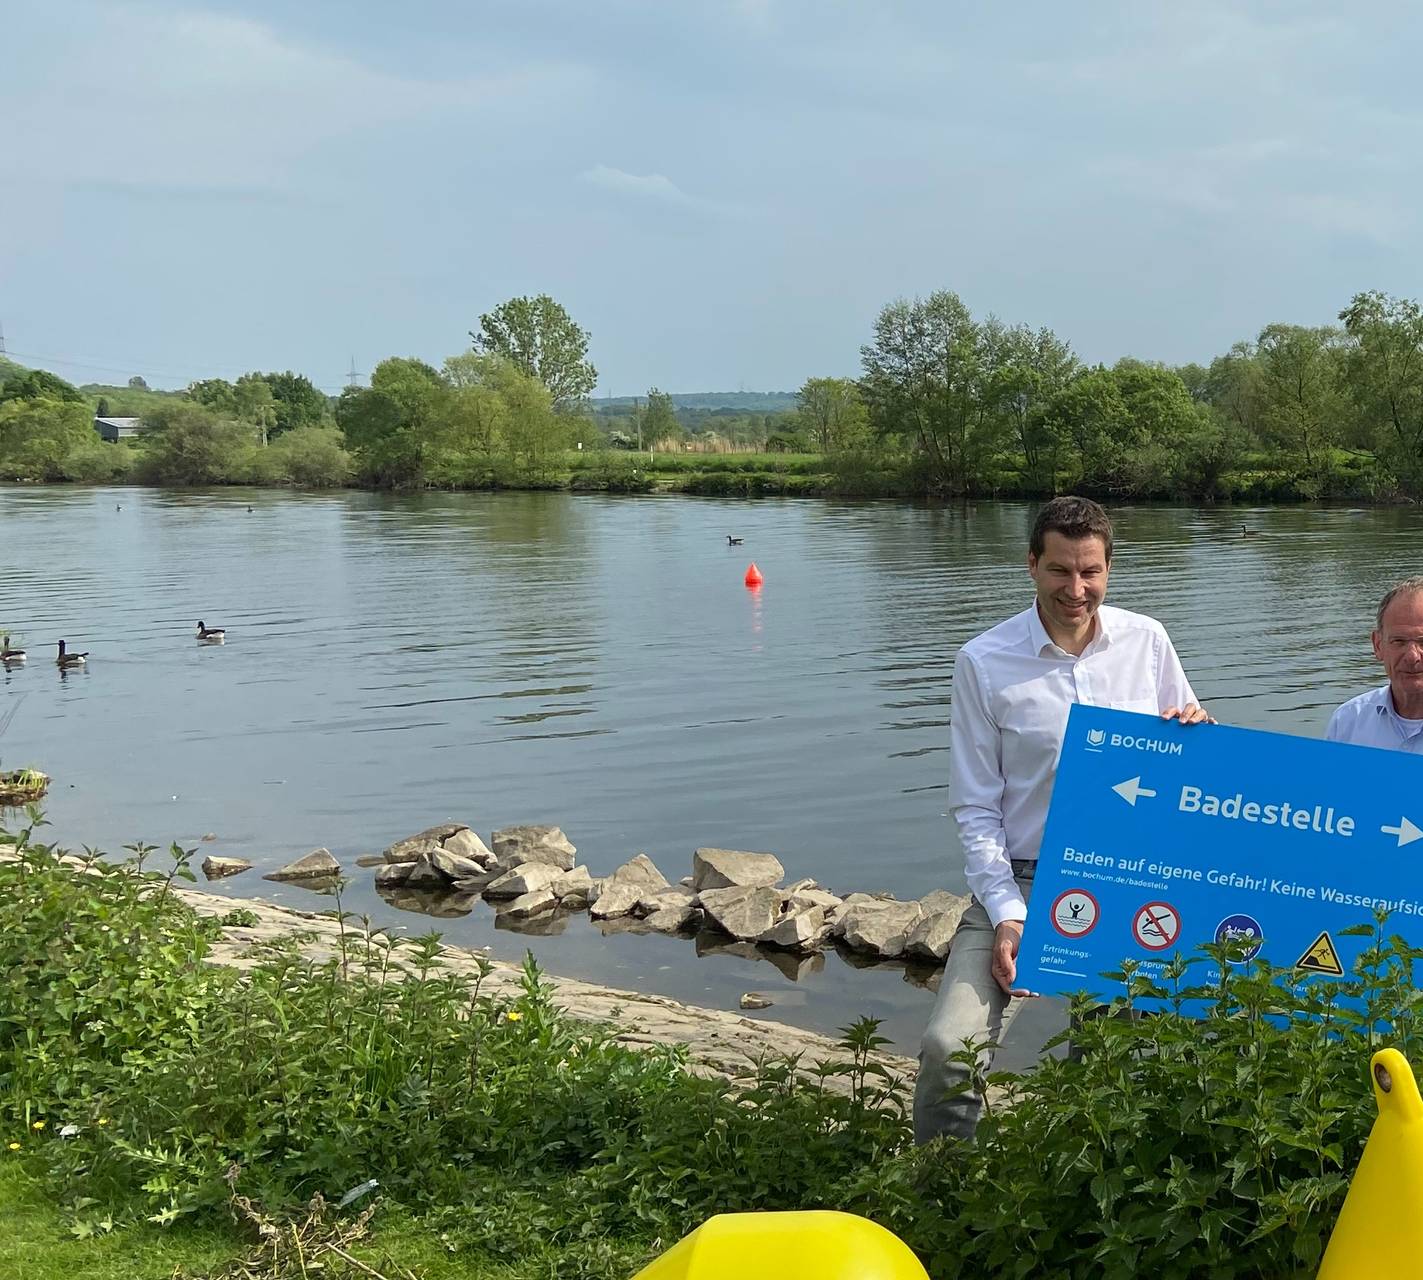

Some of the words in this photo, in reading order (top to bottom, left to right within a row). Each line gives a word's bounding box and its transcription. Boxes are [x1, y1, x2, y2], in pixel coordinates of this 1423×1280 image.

[1110, 734, 1183, 756] BOCHUM
[1178, 785, 1355, 836] Badestelle
[1063, 847, 1114, 867] Baden
[1118, 858, 1146, 872] auf
[1148, 862, 1202, 880] eigene
[1206, 869, 1267, 891] Gefahr!
[1270, 879, 1316, 899] Keine
[1040, 955, 1066, 966] gefahr
[1043, 943, 1092, 959] Ertrinkungs-
